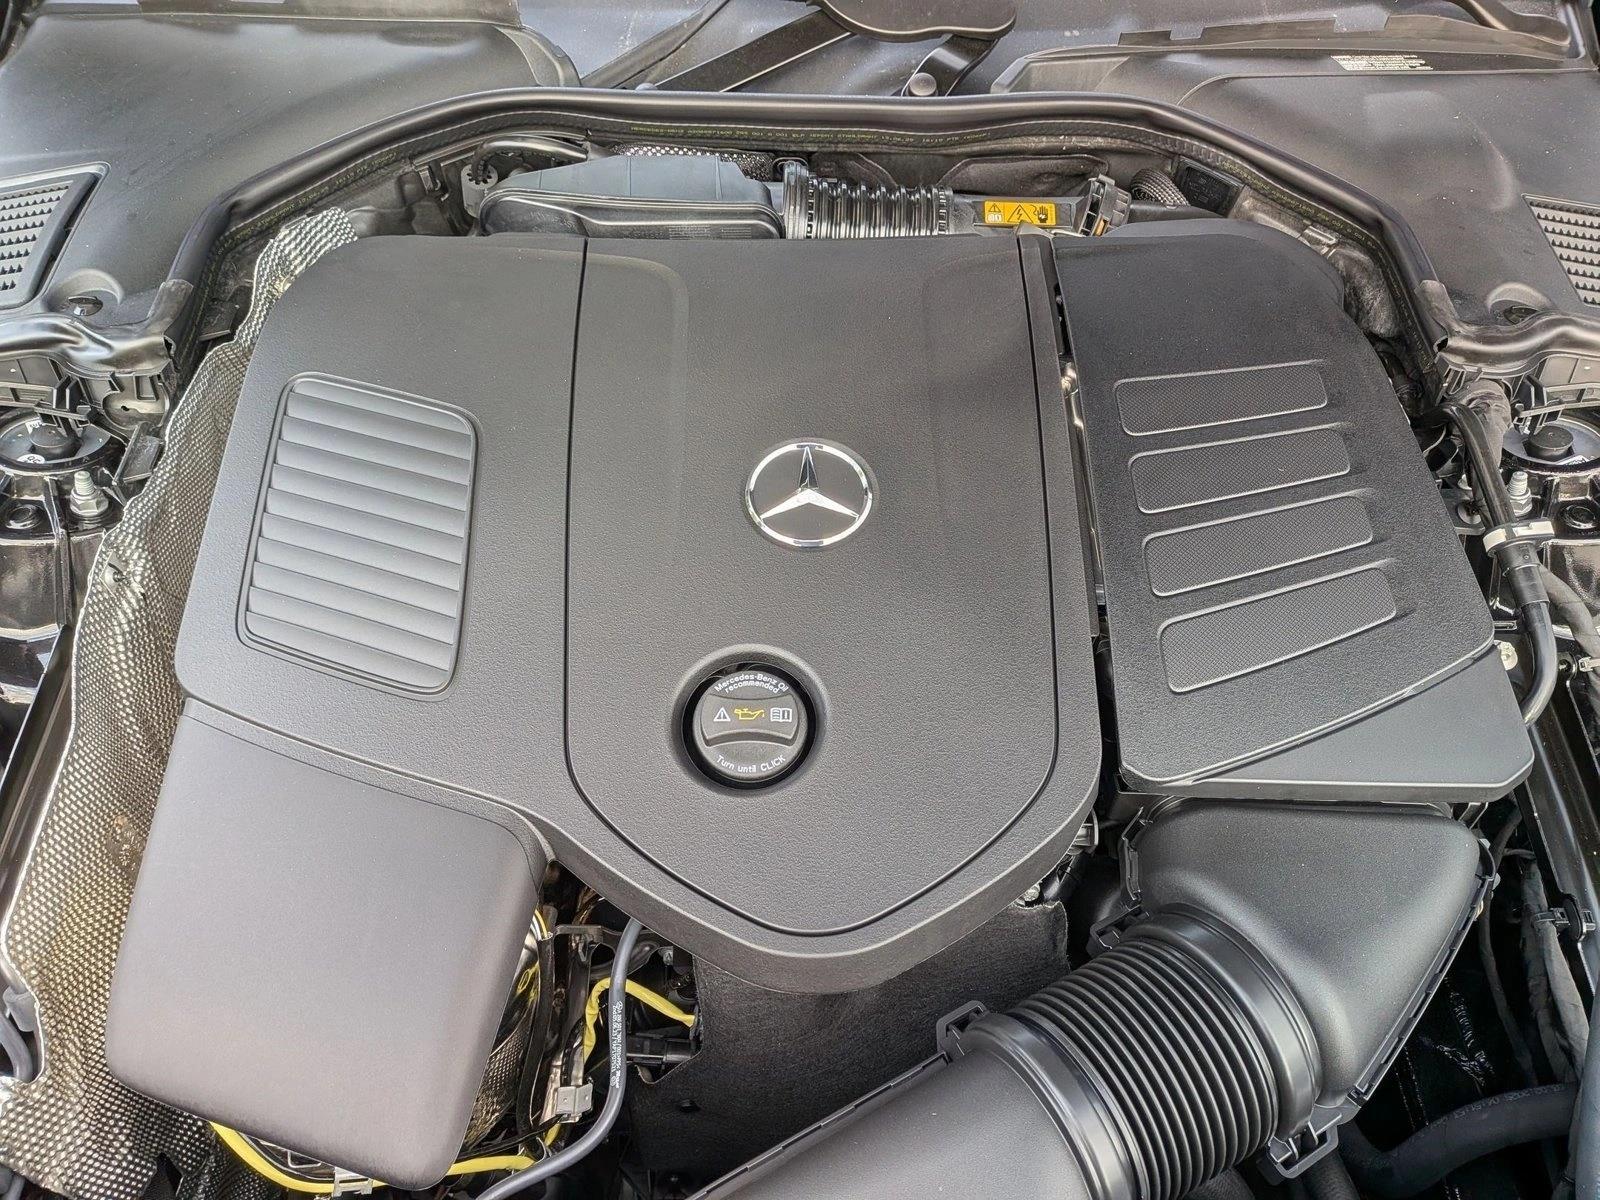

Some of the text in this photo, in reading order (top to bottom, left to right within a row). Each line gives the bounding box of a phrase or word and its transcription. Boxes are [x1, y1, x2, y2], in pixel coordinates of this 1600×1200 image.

[714, 673, 789, 692] Mercedes-Benz Oil
[725, 680, 780, 694] recommended
[716, 754, 786, 774] Turn until CLICK
